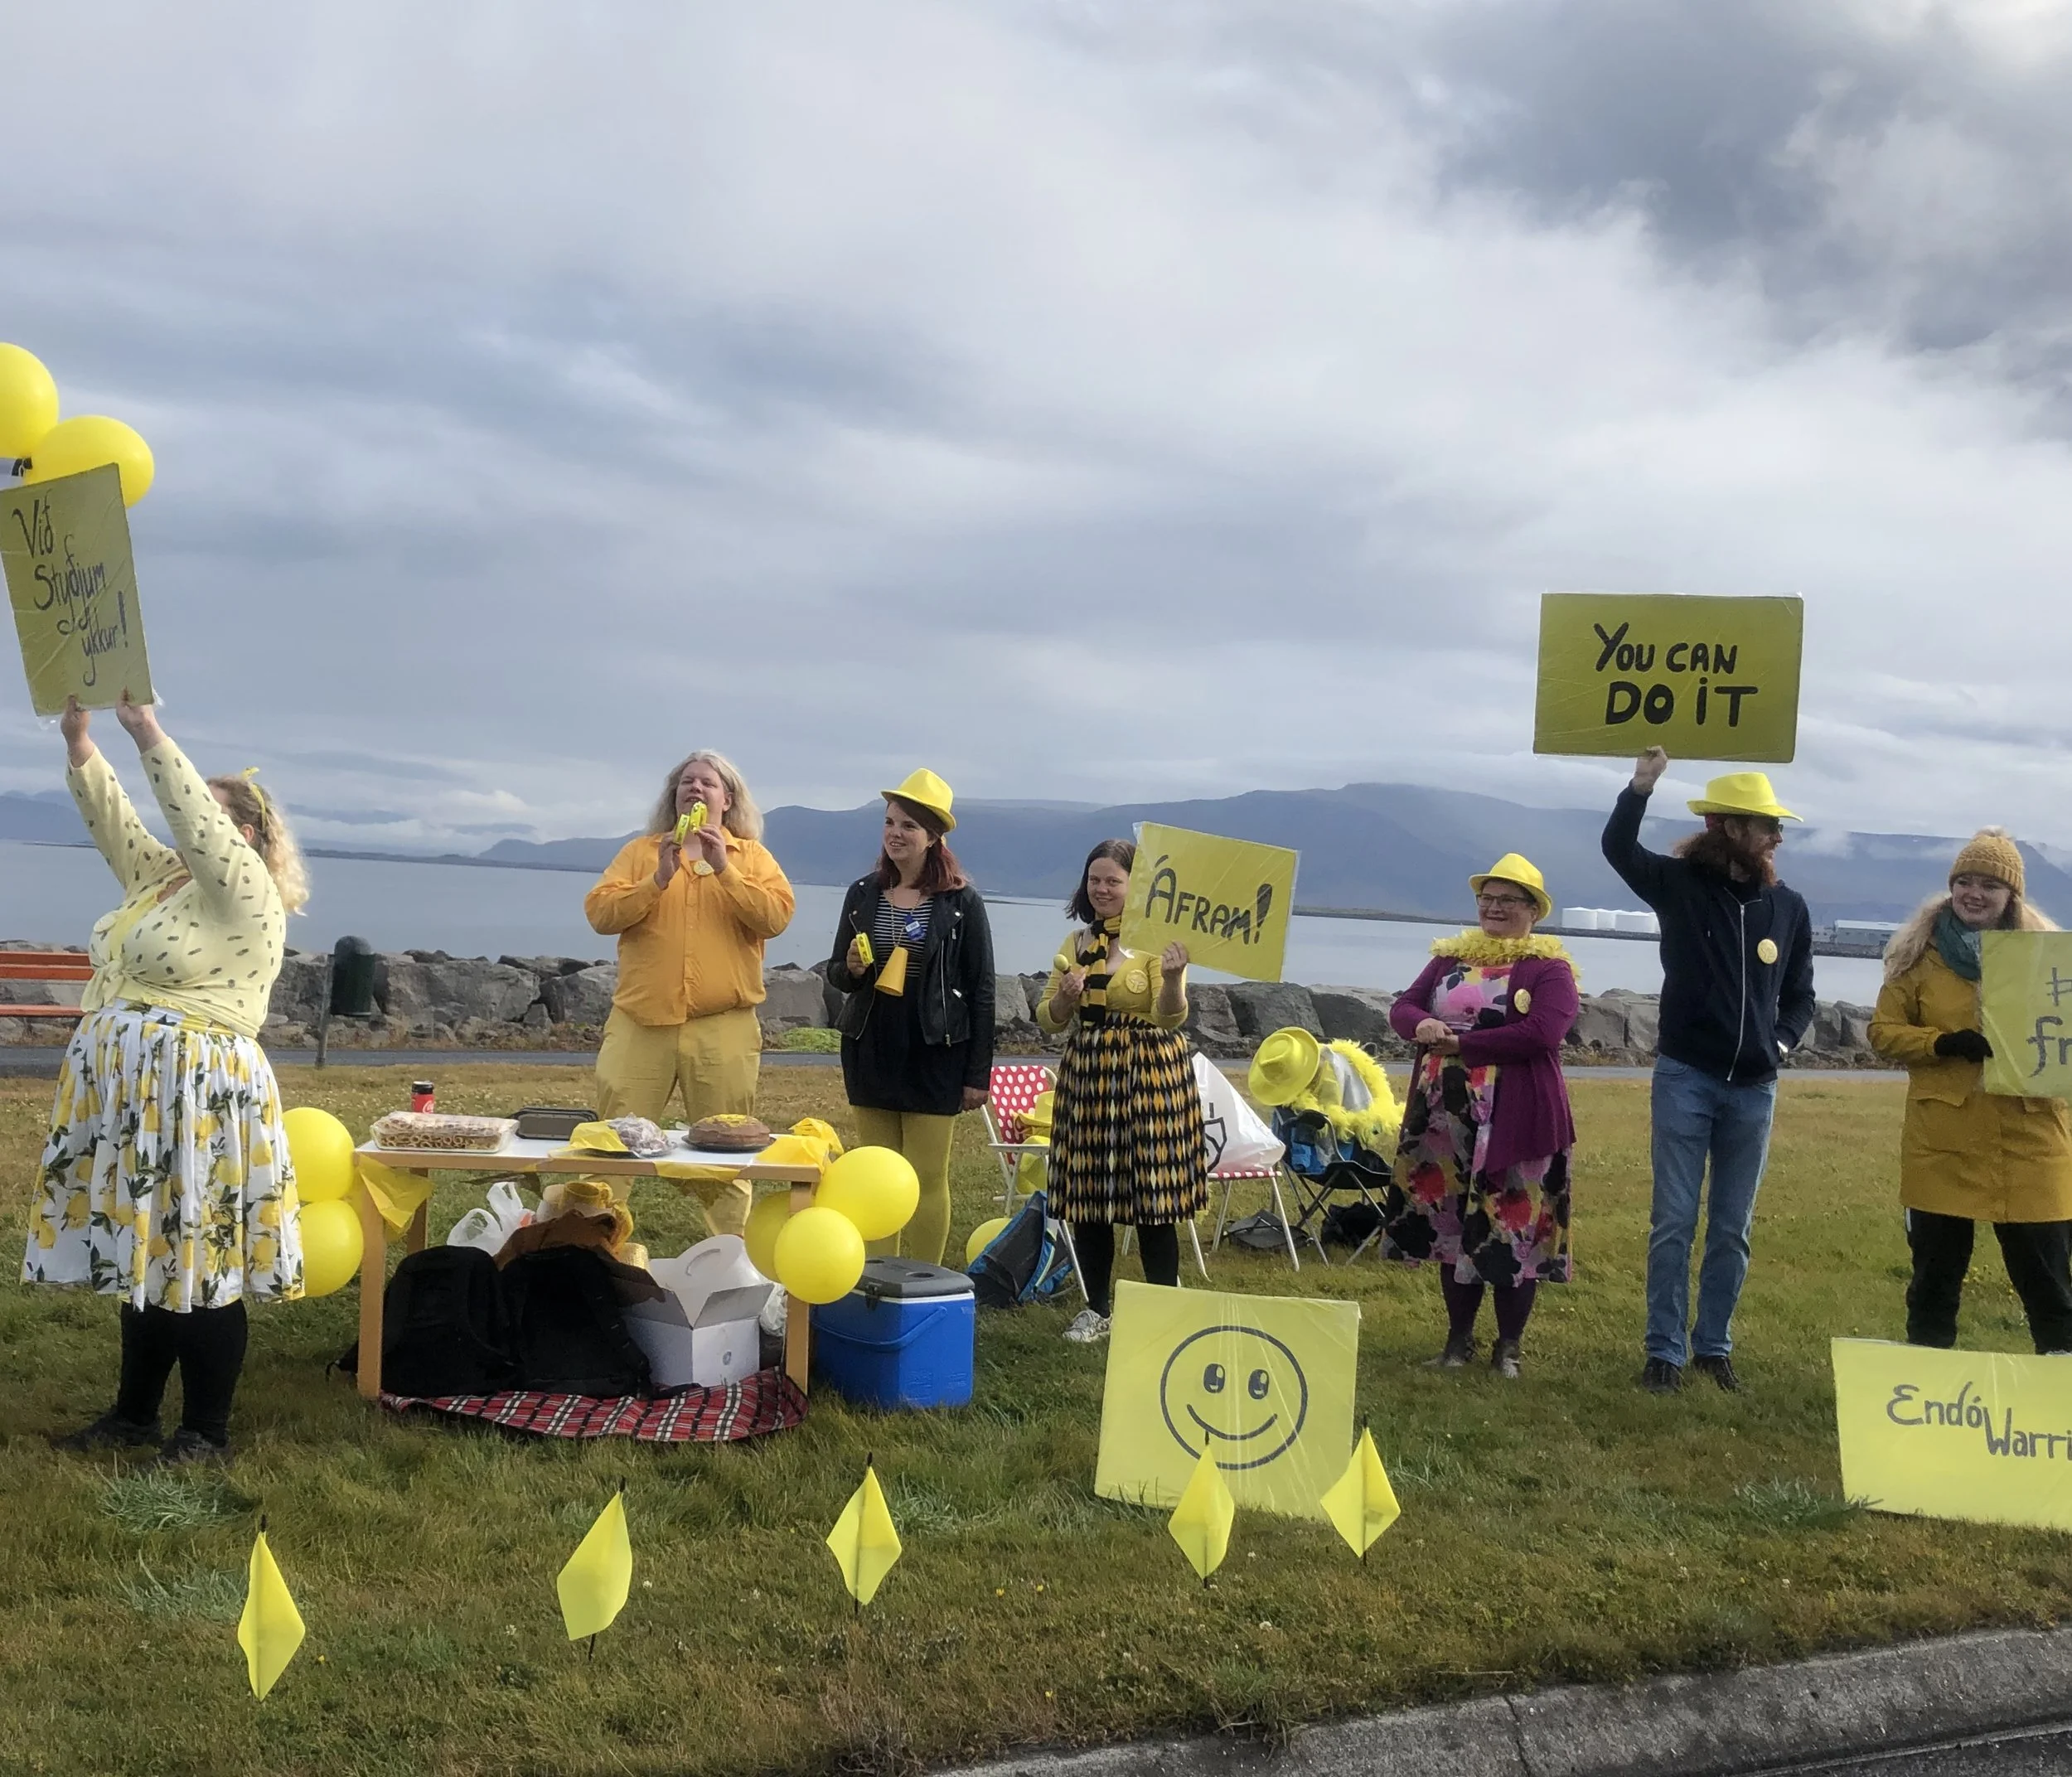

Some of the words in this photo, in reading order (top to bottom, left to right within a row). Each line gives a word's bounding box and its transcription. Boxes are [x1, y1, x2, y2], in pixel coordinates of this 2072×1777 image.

[1666, 642, 1738, 674] CAN
[1605, 680, 1674, 725] DO
[1145, 855, 1273, 945] ÁFRAM!
